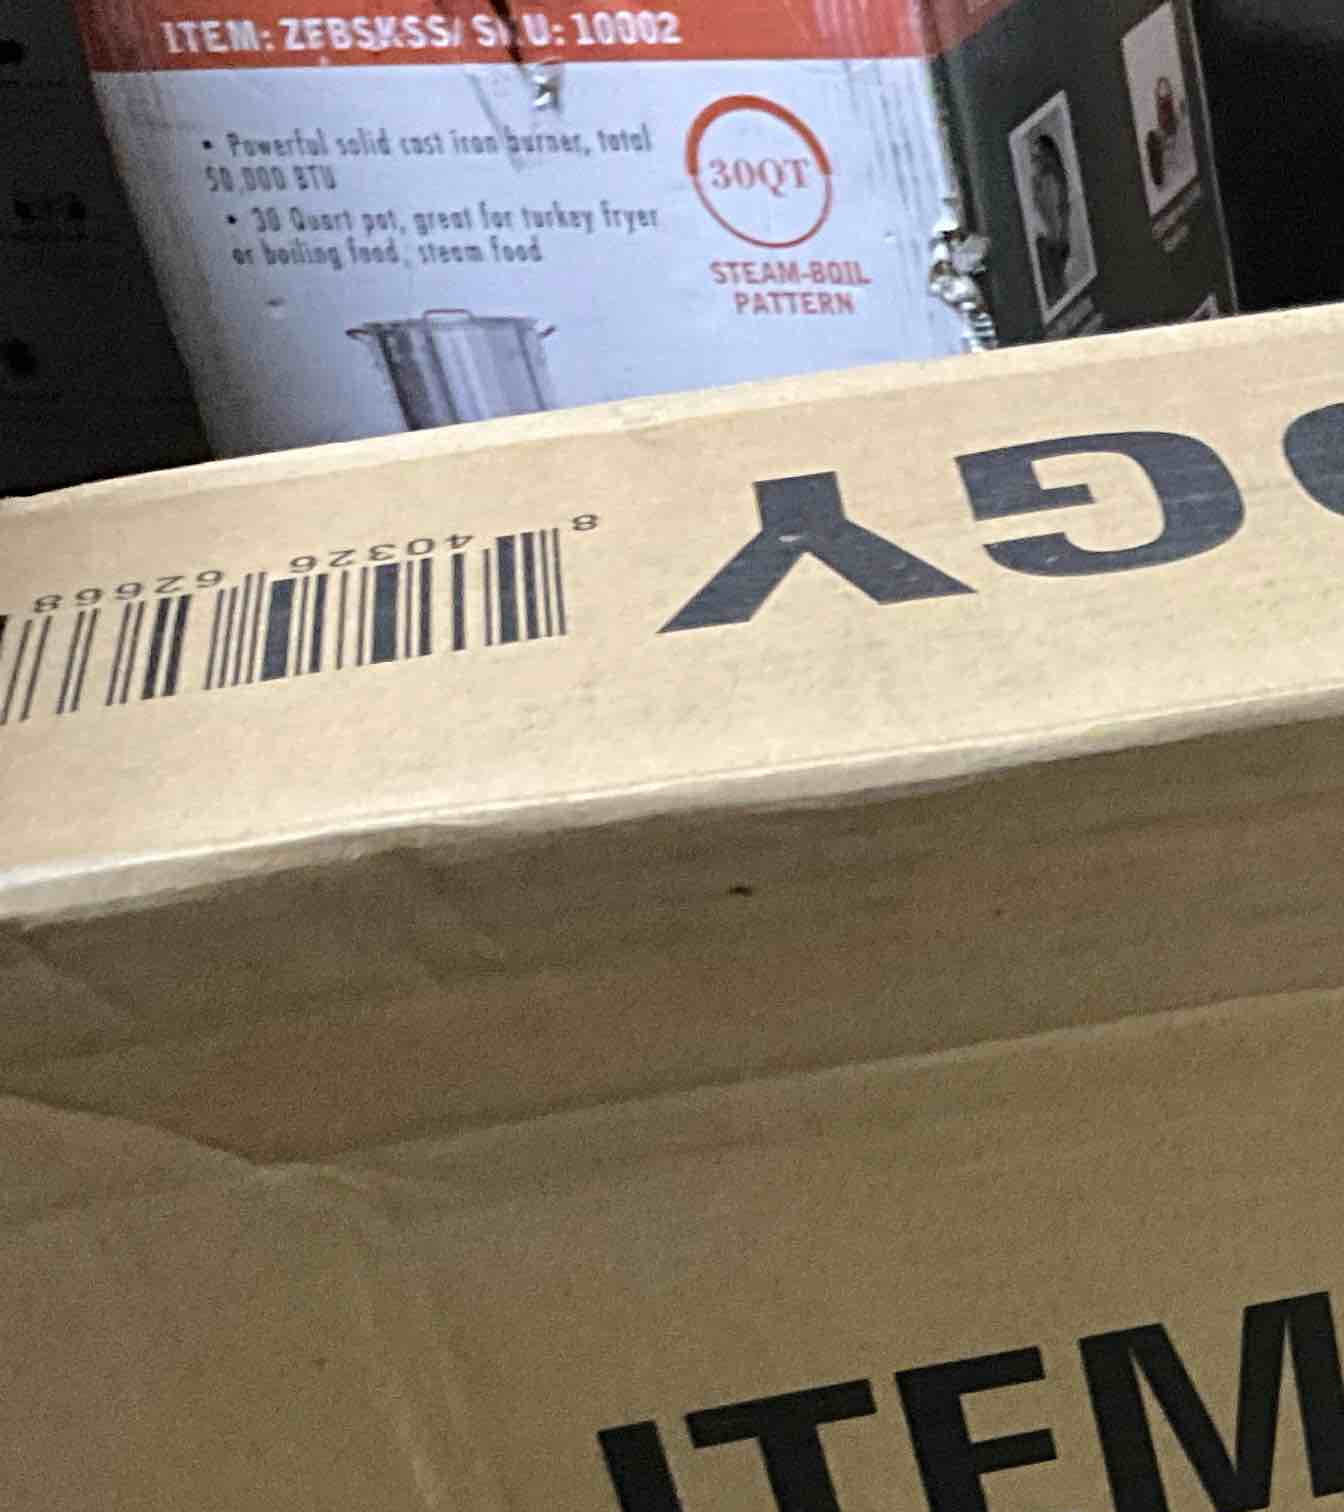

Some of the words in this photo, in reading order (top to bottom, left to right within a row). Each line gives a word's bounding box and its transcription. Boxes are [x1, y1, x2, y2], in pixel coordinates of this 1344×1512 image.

[162, 19, 275, 54] ITEM:
[569, 12, 683, 46] 10002
[226, 127, 329, 157] Powerful
[335, 127, 391, 156] solid
[400, 132, 445, 155] cast
[449, 128, 500, 153] iron
[597, 121, 653, 152] total
[708, 157, 811, 198] 30QT
[289, 206, 352, 232] Quart
[413, 205, 473, 236] great
[477, 200, 512, 229] for
[521, 199, 596, 236] turkey
[599, 199, 658, 236] fryer
[231, 247, 254, 265] or
[417, 241, 484, 264] steam
[489, 235, 543, 263] food
[709, 260, 872, 286] STEAM-BOIL
[734, 291, 855, 316] PATTERN
[572, 513, 599, 532] 8
[290, 532, 473, 573] 40326
[33, 568, 223, 613] 62668
